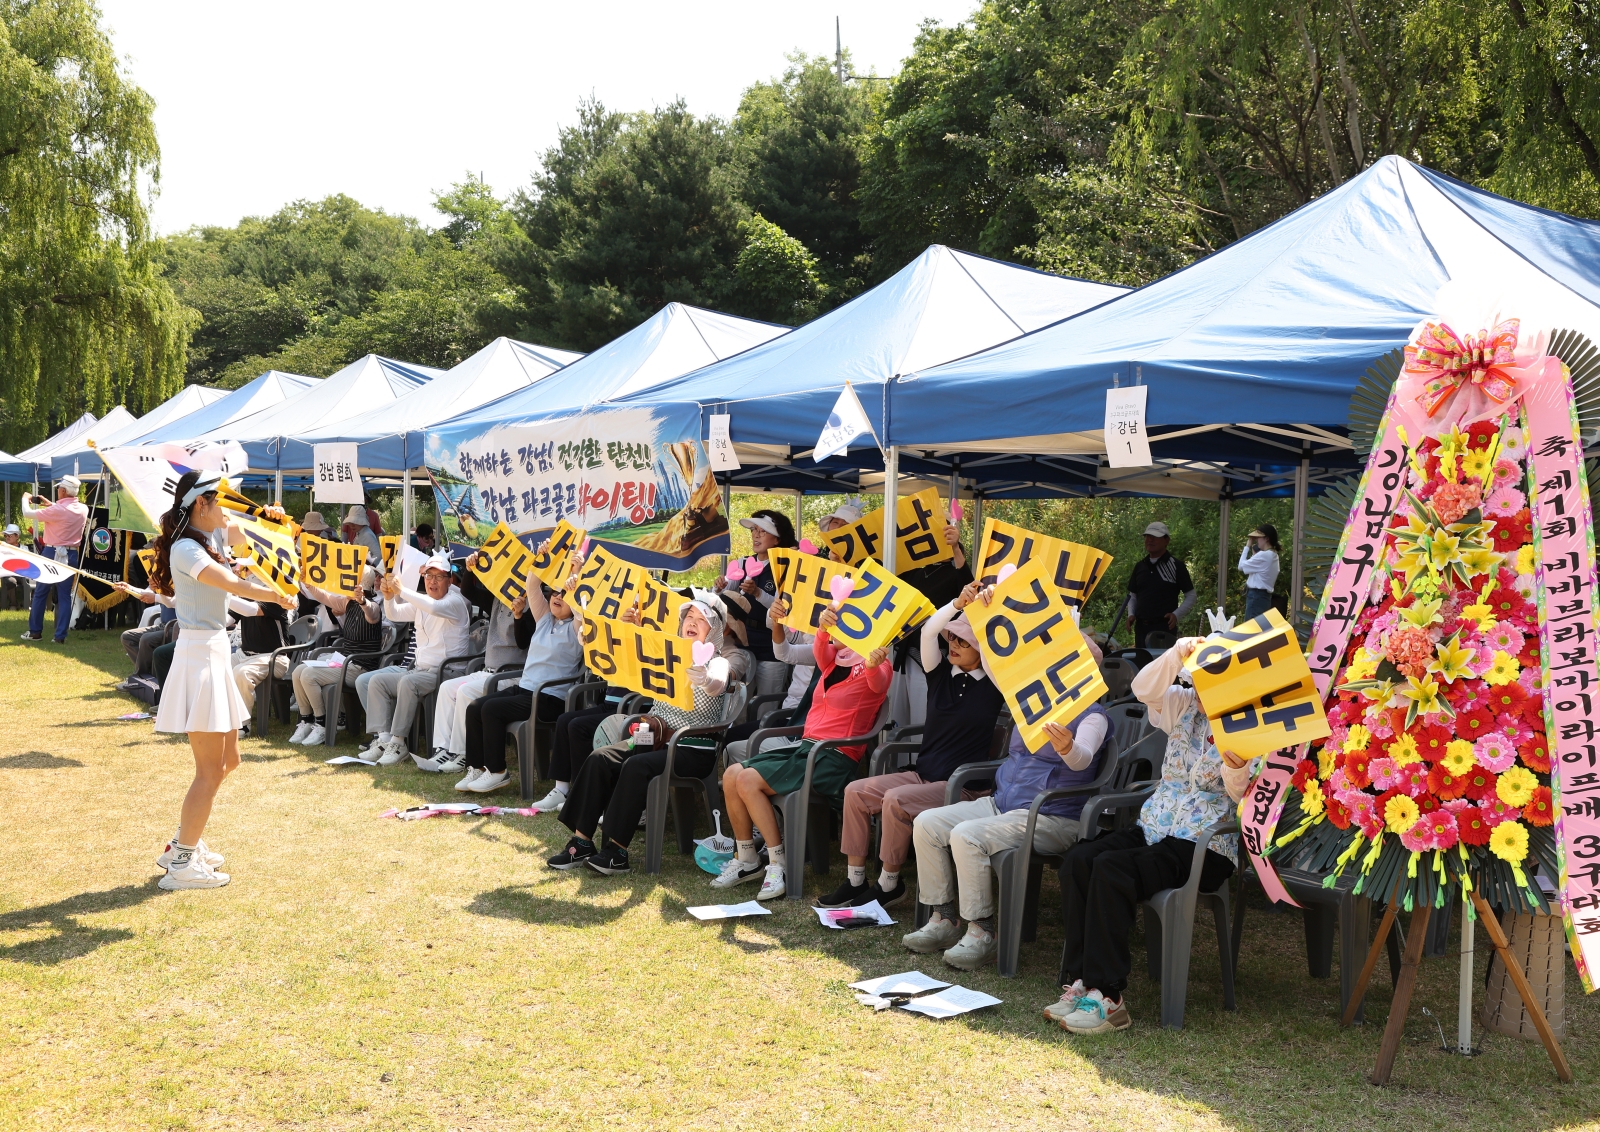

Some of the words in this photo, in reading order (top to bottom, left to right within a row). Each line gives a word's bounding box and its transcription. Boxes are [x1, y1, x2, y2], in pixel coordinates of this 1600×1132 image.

[715, 438, 727, 449] 강남
[1118, 420, 1138, 435] 강남
[1126, 441, 1133, 454] 1
[1534, 435, 1573, 457] 축
[319, 462, 335, 482] 강남
[336, 462, 354, 482] 협회
[459, 448, 514, 481] 함께하는
[517, 440, 554, 476] 강남!
[557, 437, 604, 472] 건강한
[607, 440, 653, 471] 탄천!
[720, 452, 727, 462] 2
[481, 486, 518, 524] 강남
[521, 482, 577, 523] 파크골프
[1537, 469, 1577, 540] 제1회
[829, 498, 940, 562] 강남
[305, 541, 362, 591] 강남
[475, 528, 531, 604] 강남
[573, 554, 635, 619] 강남
[582, 618, 682, 699] 강남
[985, 577, 1094, 726] 강남
